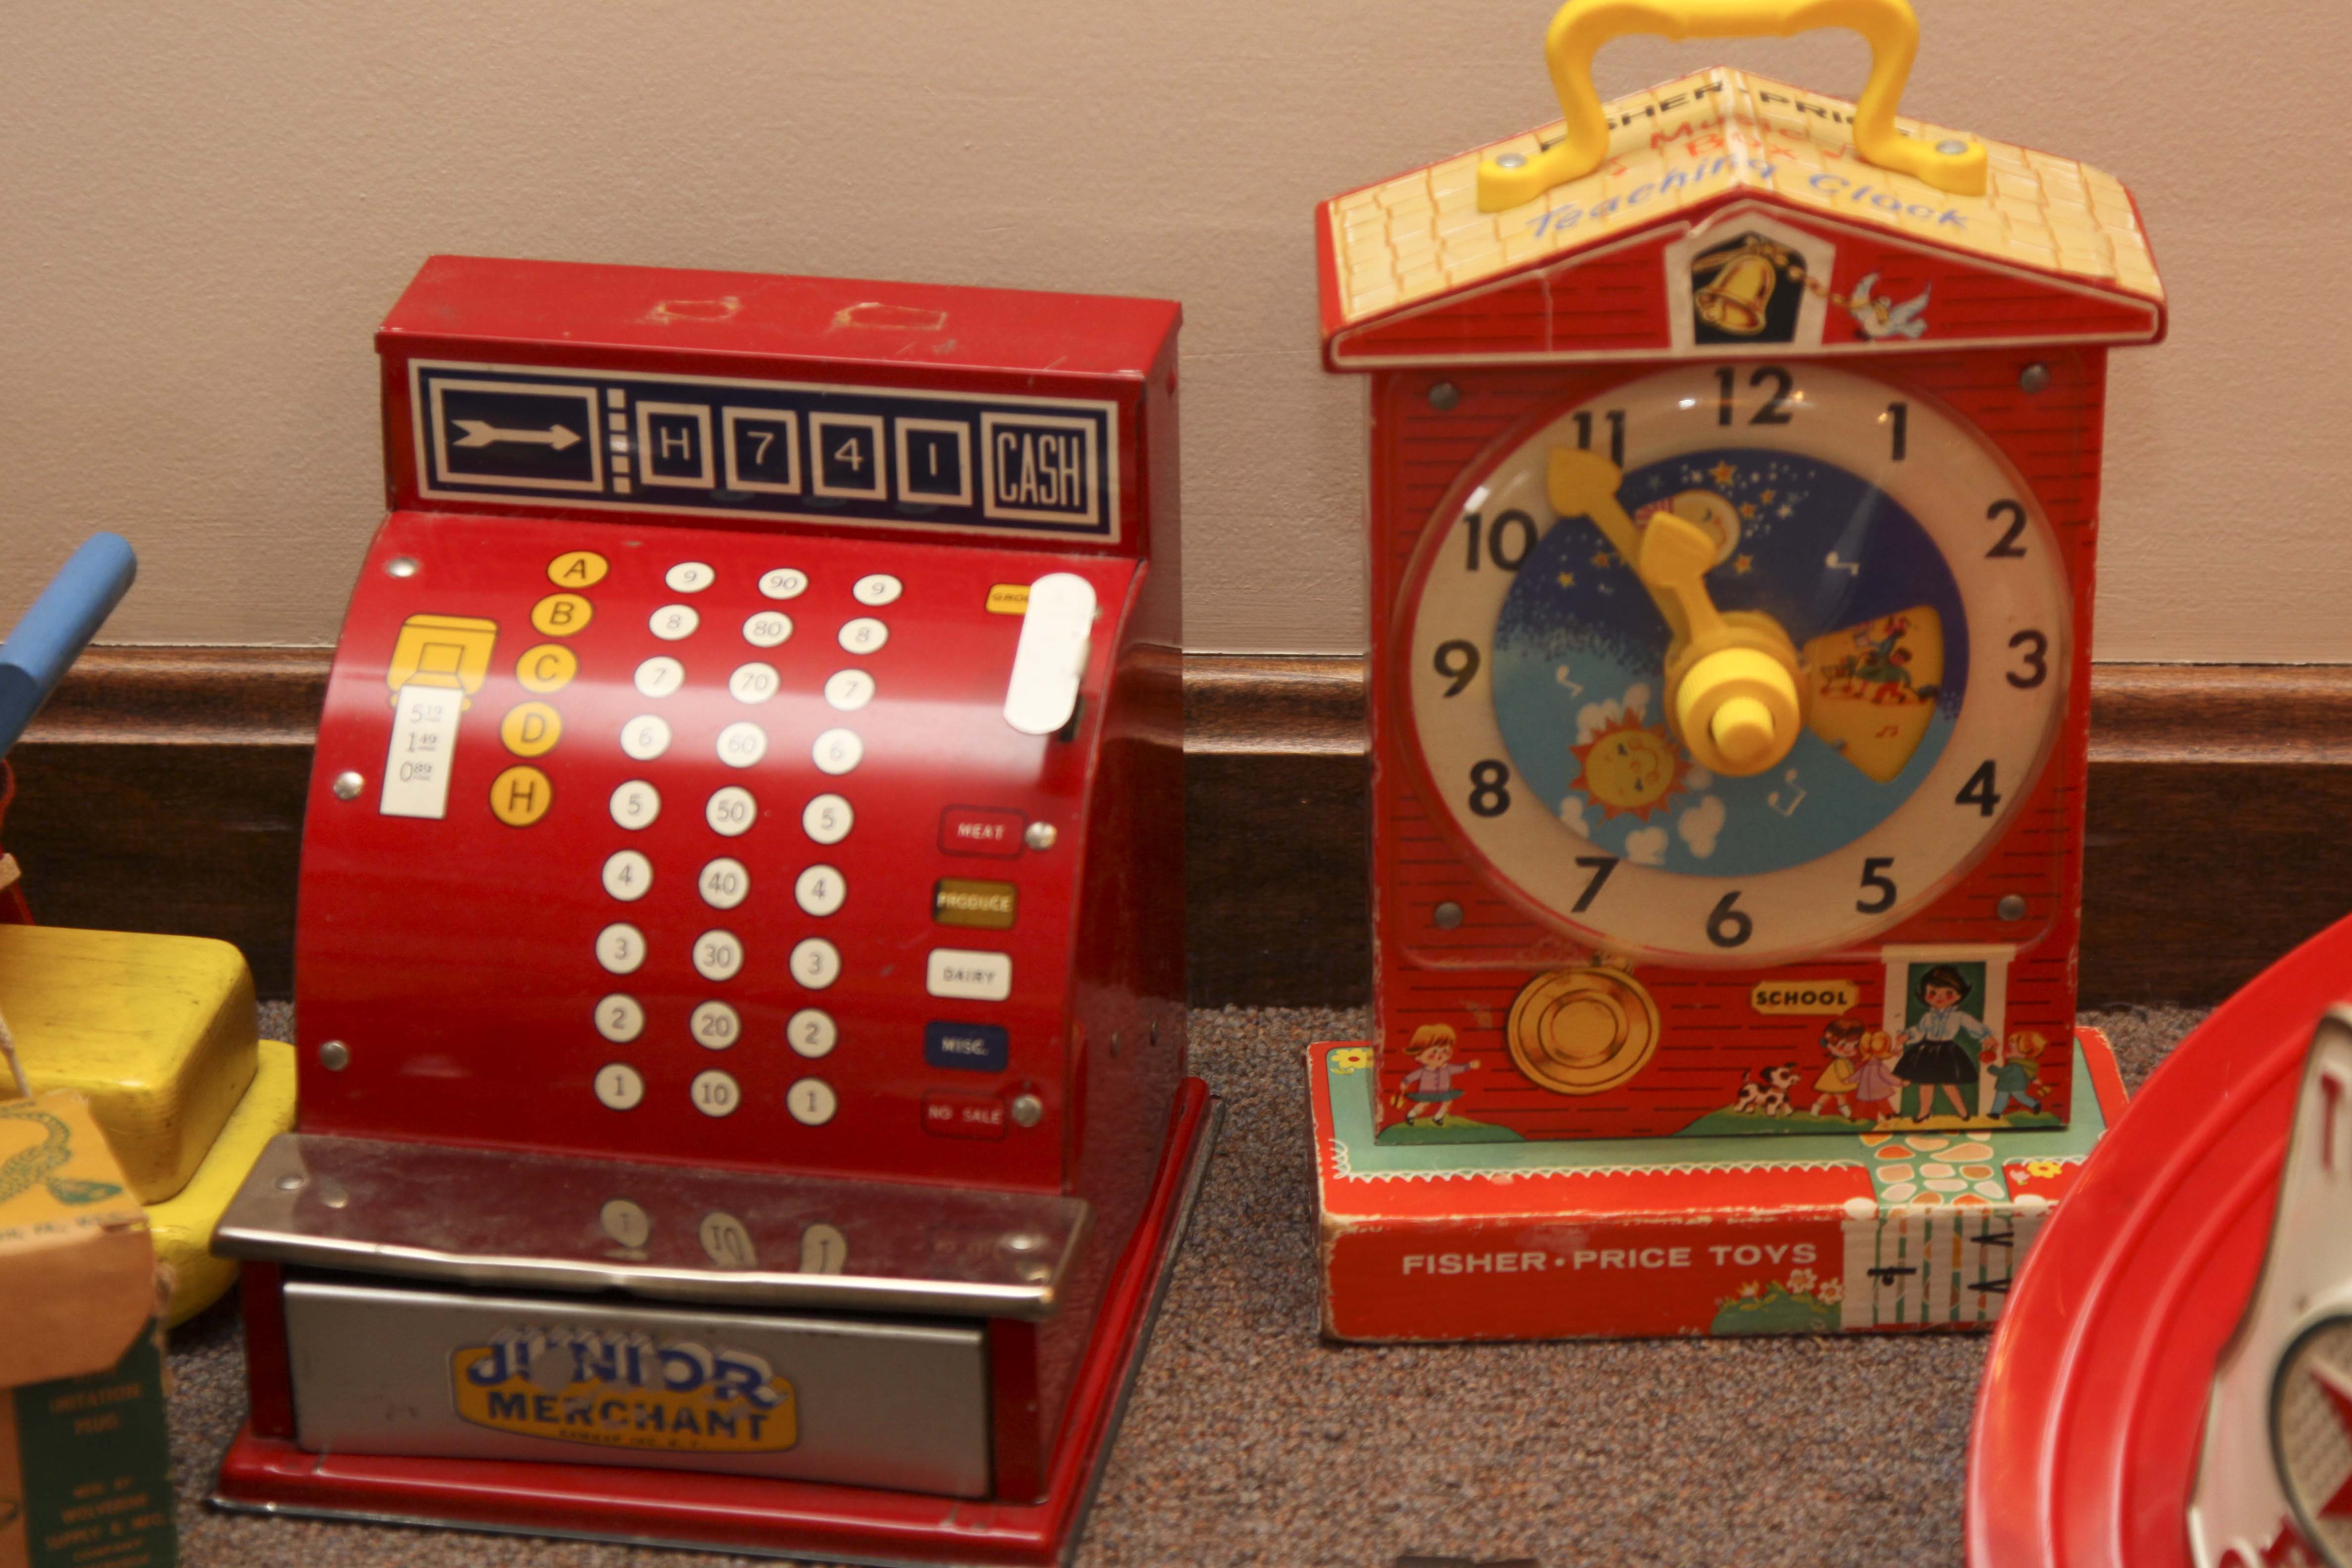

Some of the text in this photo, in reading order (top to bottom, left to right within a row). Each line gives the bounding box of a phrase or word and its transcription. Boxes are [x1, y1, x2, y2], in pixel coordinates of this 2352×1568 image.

[1540, 80, 1722, 152] FSHER
[1524, 152, 1969, 238] Teaching Clock
[1714, 365, 1794, 426] 12
[1572, 409, 1626, 468] 11
[1887, 401, 1907, 461] 1
[660, 426, 690, 461] H
[747, 431, 775, 465] 7
[834, 437, 864, 472] 4
[997, 432, 1081, 508] CASH
[1463, 508, 1538, 572] 10
[1985, 498, 2028, 559] 2
[563, 558, 588, 579] A
[684, 570, 697, 584] 9
[769, 575, 798, 590] 90
[871, 582, 885, 595] 9
[549, 601, 575, 626] B
[666, 614, 681, 630] 8
[752, 621, 782, 637] 80
[855, 627, 871, 643] 8
[535, 654, 559, 683] C
[1432, 638, 1481, 698] 9
[2005, 629, 2048, 689] 3
[653, 667, 668, 686] 7
[740, 673, 768, 690] 70
[843, 681, 858, 698] 7
[520, 712, 547, 743] D
[638, 727, 653, 747] 6
[727, 734, 756, 754] 60
[829, 741, 844, 762] 6
[508, 779, 535, 813] H
[1468, 758, 1512, 819] 8
[1955, 759, 2001, 817] 4
[627, 793, 641, 816] 5
[716, 799, 745, 823] 50
[820, 807, 834, 830] 5
[957, 822, 1007, 840] MEAT
[618, 864, 633, 885] 4
[707, 872, 737, 896] 40
[1571, 856, 1620, 913] 7
[1856, 857, 1897, 915] 5
[811, 878, 827, 900] 4
[936, 891, 1011, 913] PRODUCE
[1706, 890, 1754, 948] 6
[614, 937, 628, 960] 3
[702, 945, 732, 969] 30
[808, 951, 822, 975] 3
[942, 967, 996, 985] DAIRY
[1756, 990, 1848, 1007] SCHOOL
[611, 1007, 626, 1029] 2
[701, 1014, 731, 1038] 20
[804, 1023, 819, 1045] 2
[614, 1076, 625, 1097] 1
[701, 1083, 729, 1106] 10
[807, 1091, 818, 1113] 1
[928, 1104, 1003, 1125] NO SALE
[1709, 1243, 1817, 1266] TOYS
[487, 1391, 768, 1441] MERCHANT
